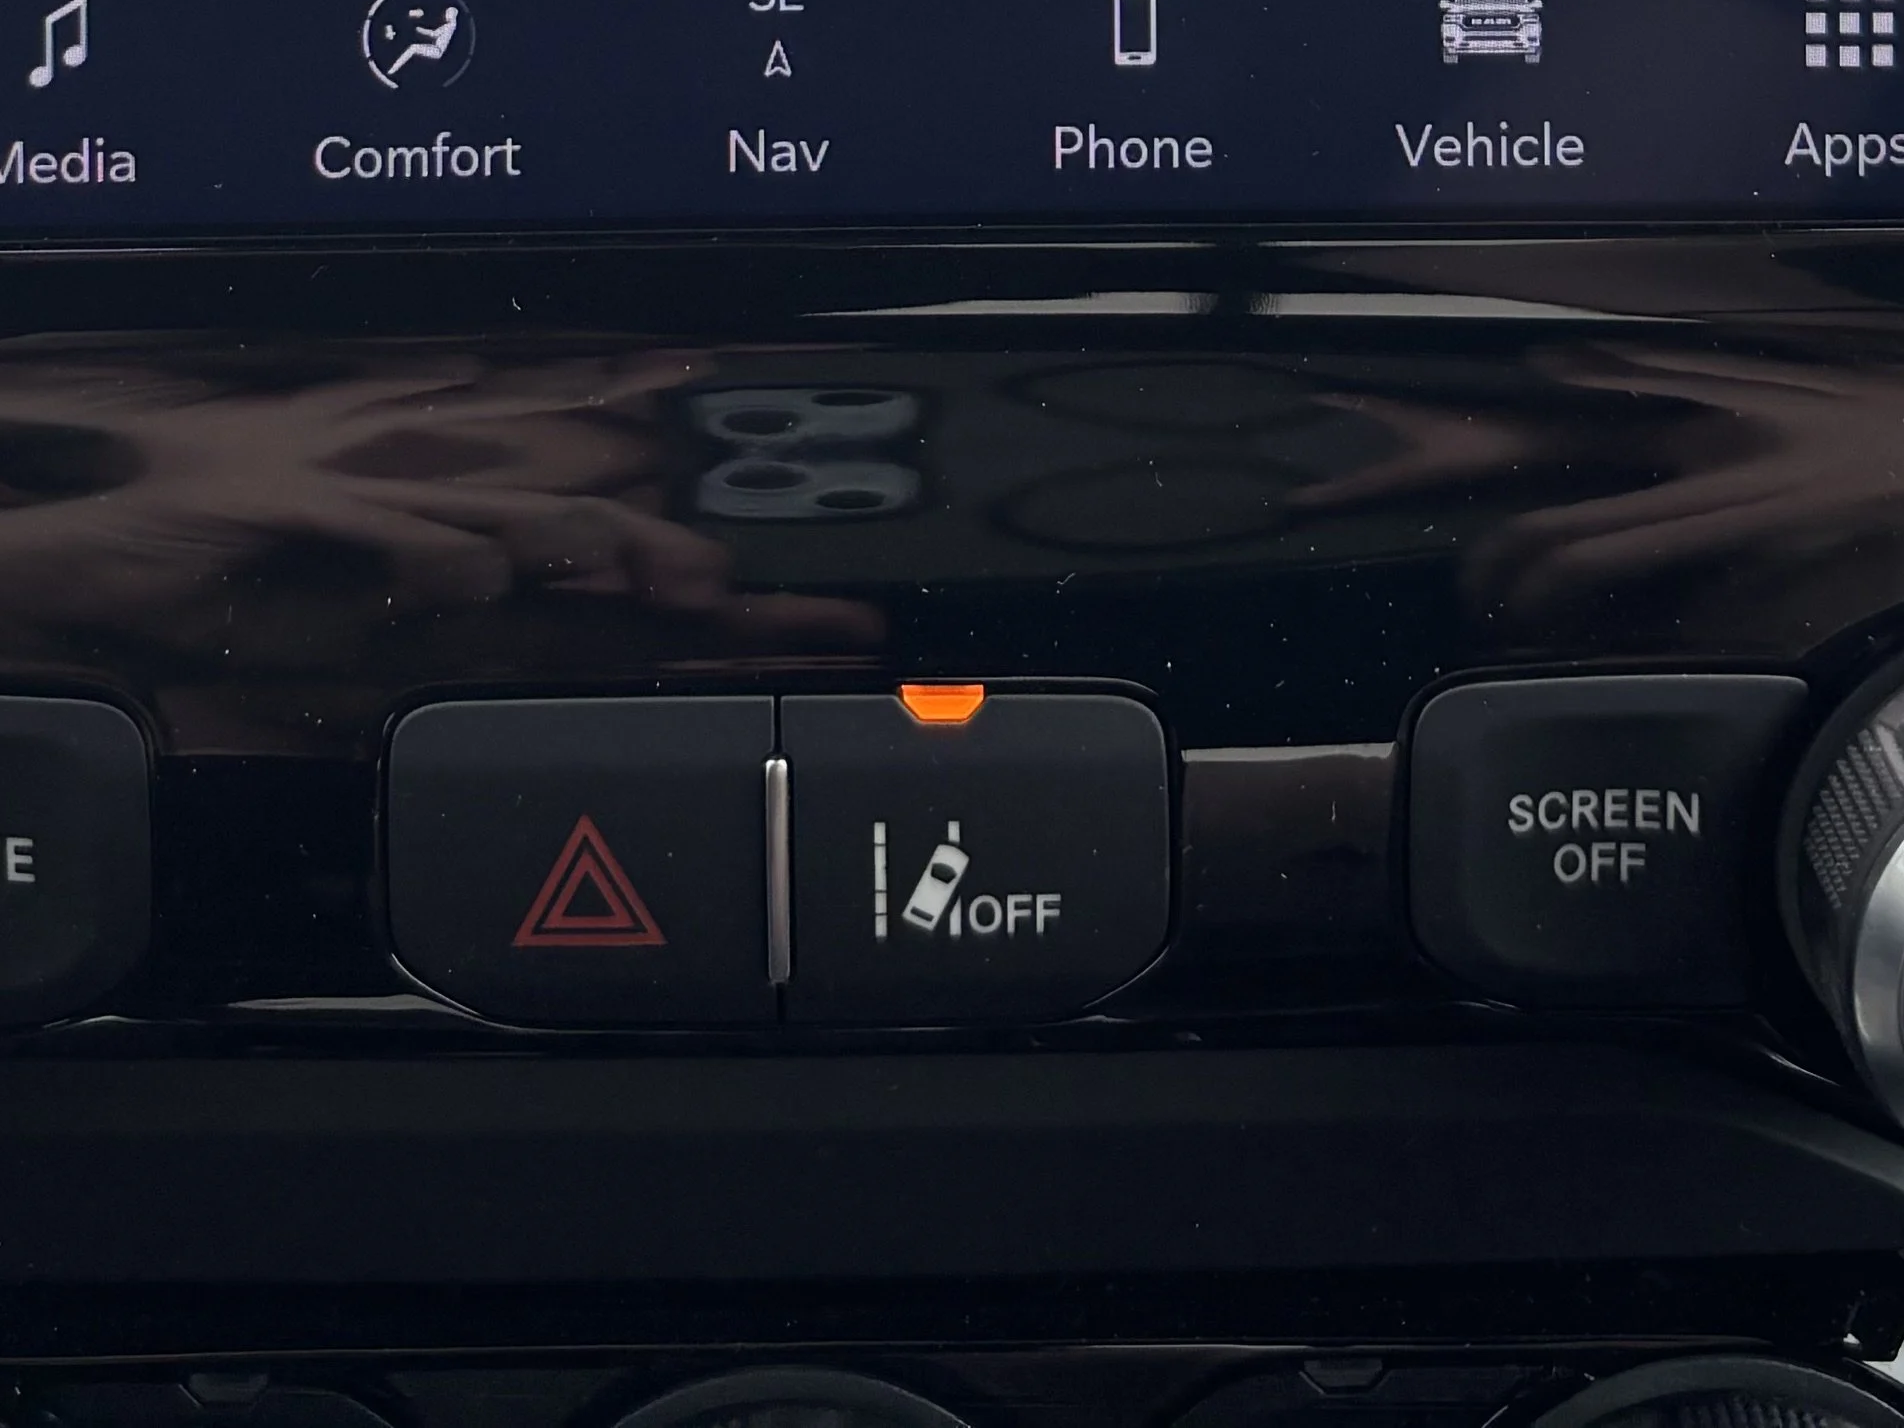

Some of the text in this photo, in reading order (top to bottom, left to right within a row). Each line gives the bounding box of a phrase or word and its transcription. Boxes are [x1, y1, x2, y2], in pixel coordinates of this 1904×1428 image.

[314, 131, 521, 180] Comfort
[729, 130, 829, 175] Nav
[1052, 126, 1213, 170] Phone
[1397, 123, 1585, 168] Vehicle
[1508, 791, 1701, 834] SCREEN
[1553, 843, 1645, 883] OFF
[969, 894, 1060, 935] OFF
